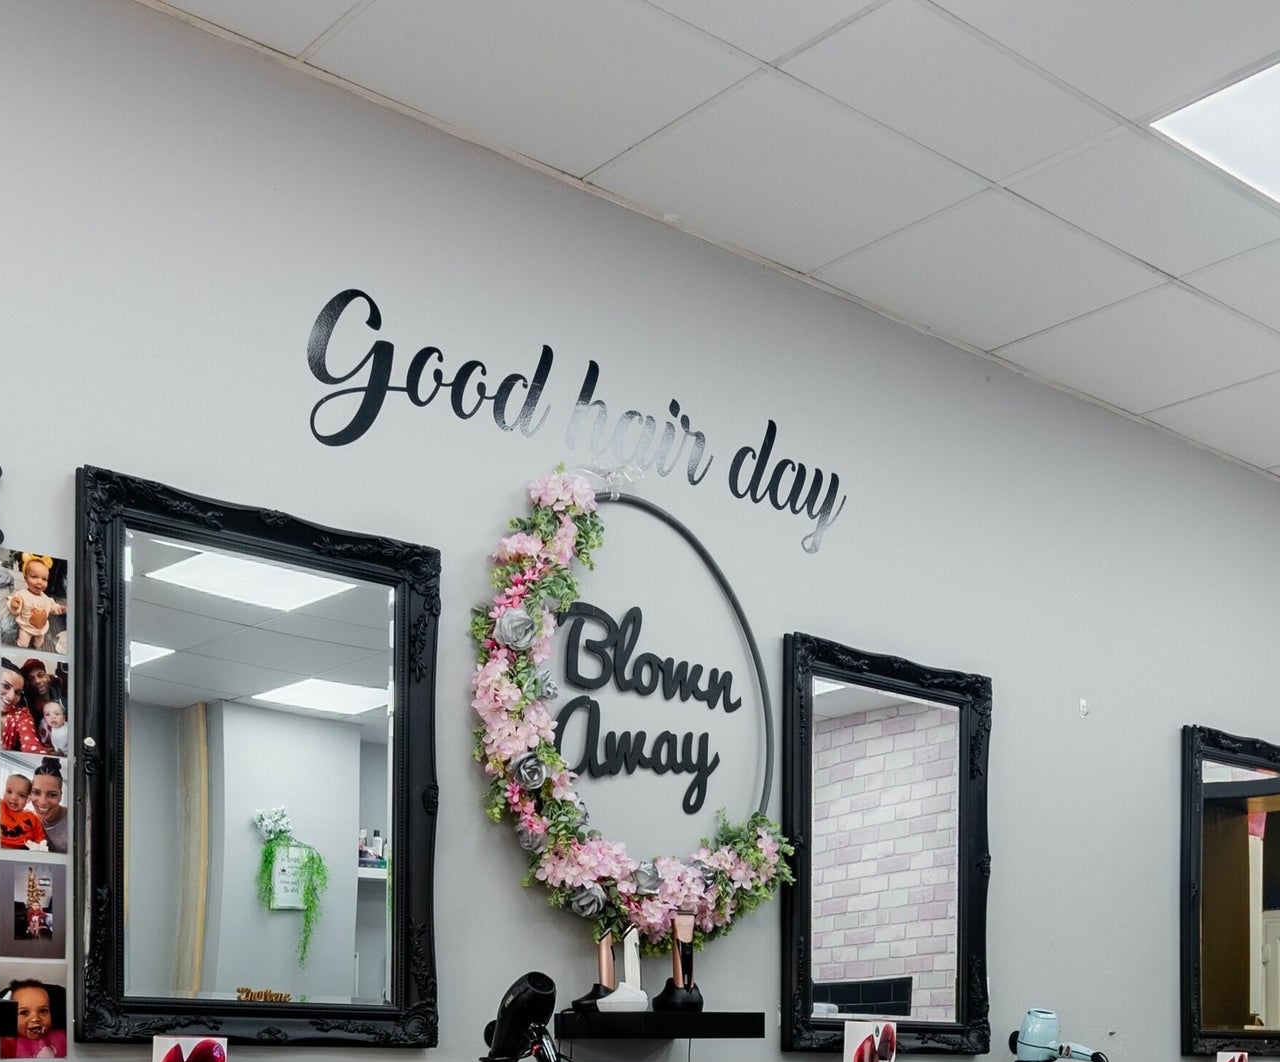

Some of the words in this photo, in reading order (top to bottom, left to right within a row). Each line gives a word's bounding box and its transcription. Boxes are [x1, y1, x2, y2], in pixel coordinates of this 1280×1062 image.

[306, 288, 554, 447] Good
[565, 360, 713, 487] hair
[728, 419, 846, 555] day
[558, 601, 742, 713] Blown
[553, 695, 720, 815] Away
